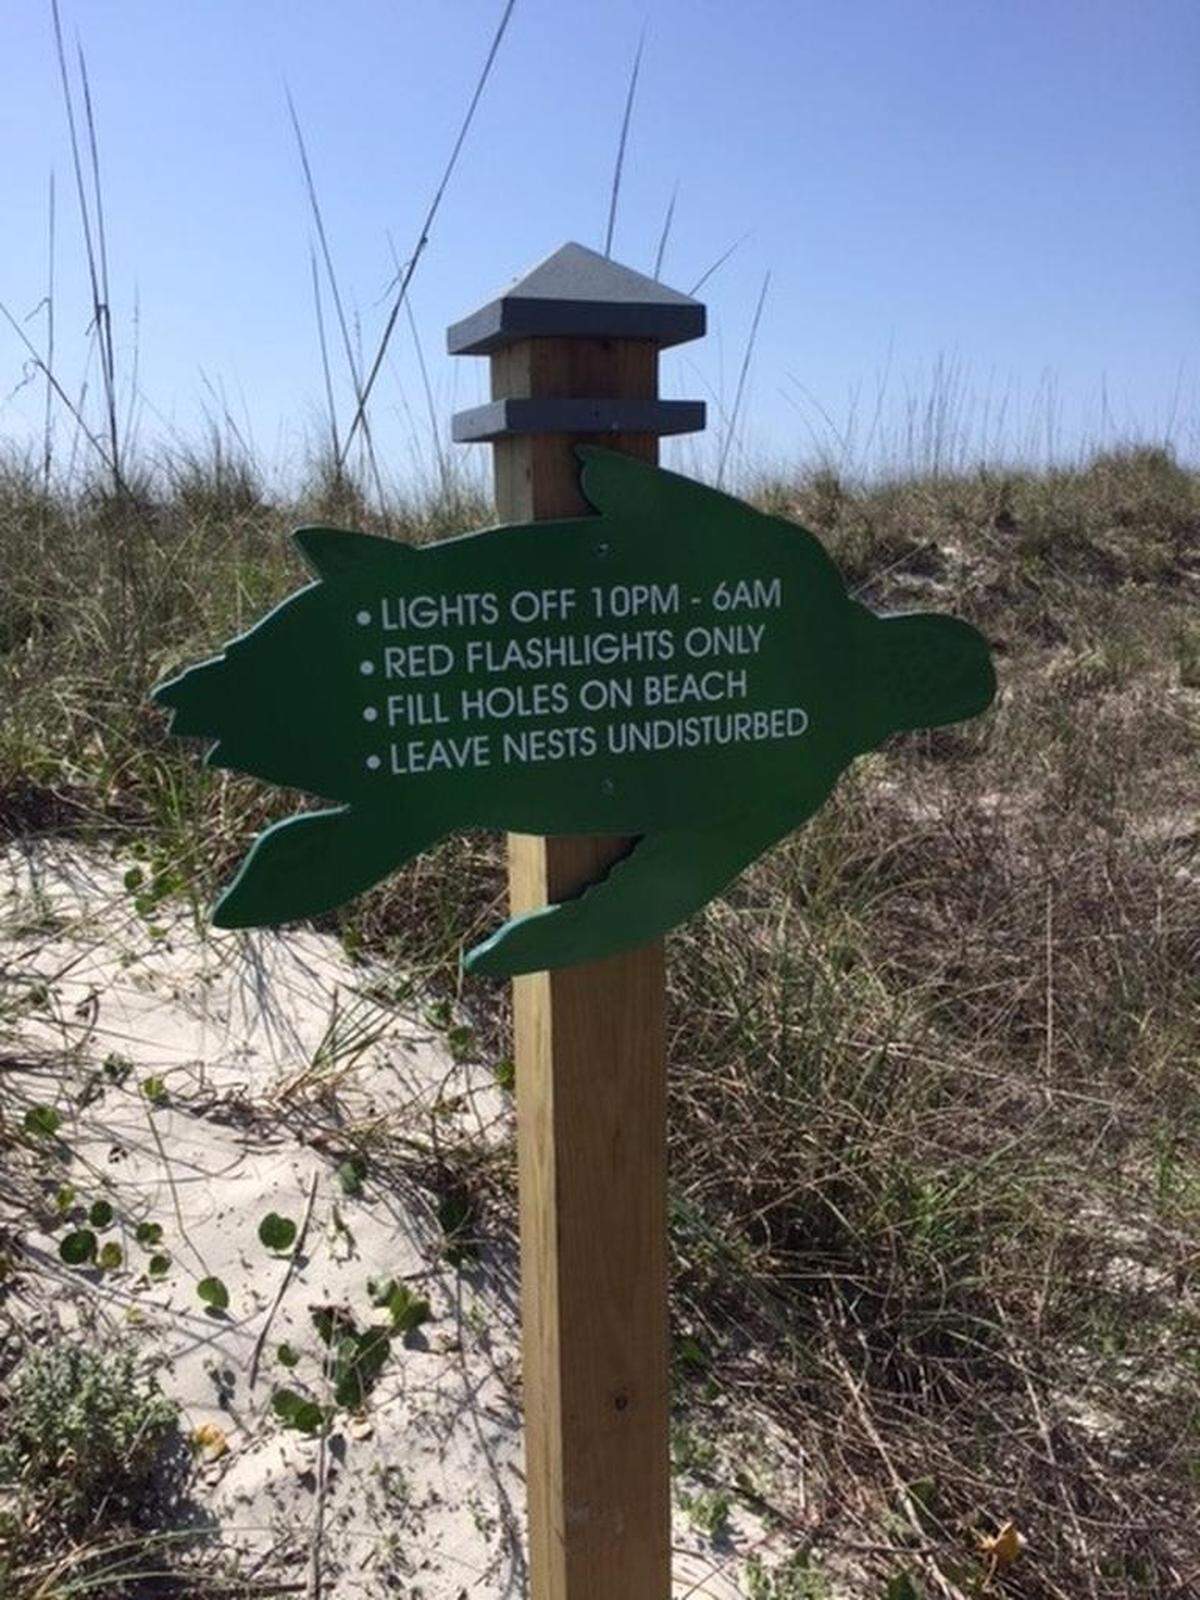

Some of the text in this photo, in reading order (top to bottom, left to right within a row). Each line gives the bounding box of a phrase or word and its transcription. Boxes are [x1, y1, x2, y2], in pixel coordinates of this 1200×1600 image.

[381, 594, 498, 630] LIGHTS
[511, 588, 574, 622] OFF
[592, 584, 680, 618] 10PM
[712, 578, 782, 611] 6AM
[384, 625, 765, 678] RED FLASHLIGHTS ONLY
[387, 670, 748, 727] FILL HOLES ON BEACH
[391, 708, 808, 775] LEAVE NESTS UNDISTURBED
